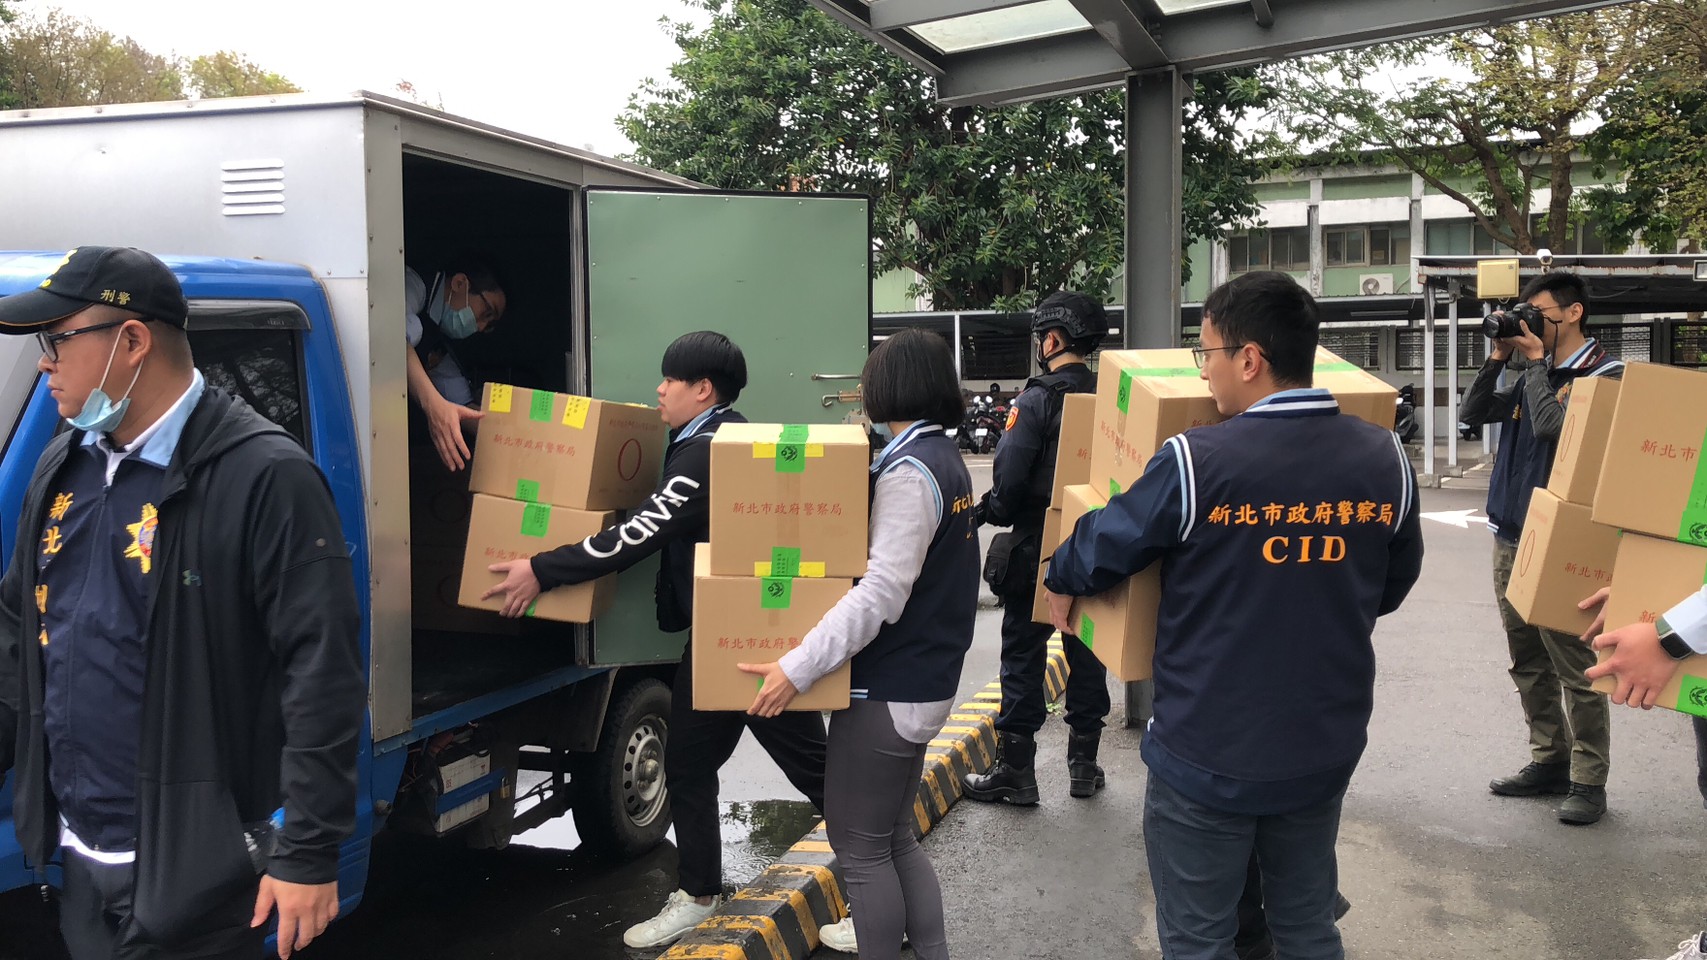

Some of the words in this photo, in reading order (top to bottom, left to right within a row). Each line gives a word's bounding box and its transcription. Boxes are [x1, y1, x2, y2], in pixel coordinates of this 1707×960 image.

[100, 289, 131, 305] 刑警
[583, 475, 700, 558] Calvin
[733, 502, 842, 516] 新北市政府警察局
[1208, 500, 1395, 526] 新北市政府警察局
[1262, 535, 1346, 563] CID
